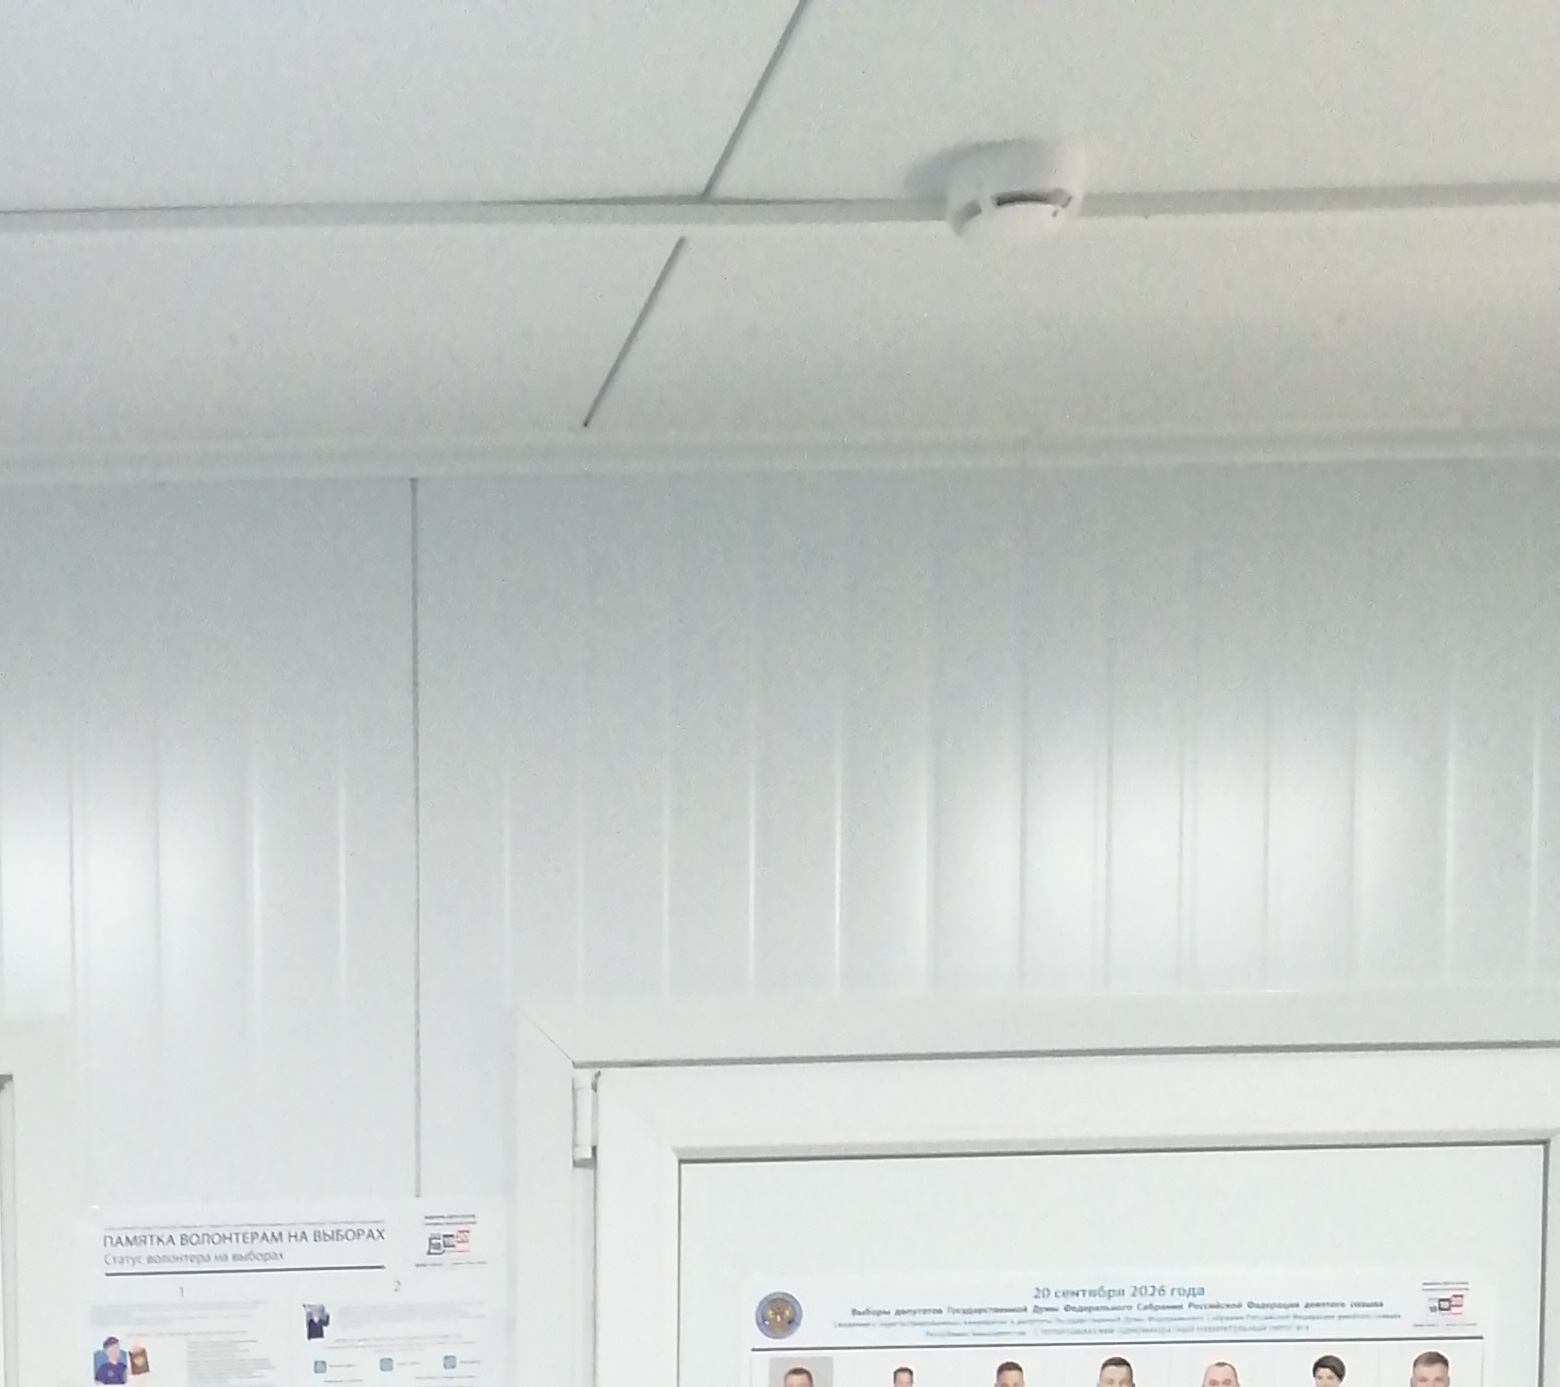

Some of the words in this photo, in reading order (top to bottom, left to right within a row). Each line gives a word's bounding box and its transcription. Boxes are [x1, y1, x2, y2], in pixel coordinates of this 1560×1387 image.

[103, 1232, 176, 1249] ПАМЯТКА
[180, 1230, 284, 1247] ВОЛОНТЕРАМ
[288, 1229, 309, 1244] НА
[313, 1227, 386, 1243] ВЫБОРАХ
[103, 1253, 143, 1267] Статус
[146, 1253, 212, 1266] волонтера
[214, 1253, 229, 1263] на
[231, 1250, 285, 1263] выборах
[1033, 1286, 1051, 1299] 20
[1053, 1285, 1126, 1300] сентября
[1130, 1284, 1167, 1298] 2026
[1170, 1285, 1206, 1299] года
